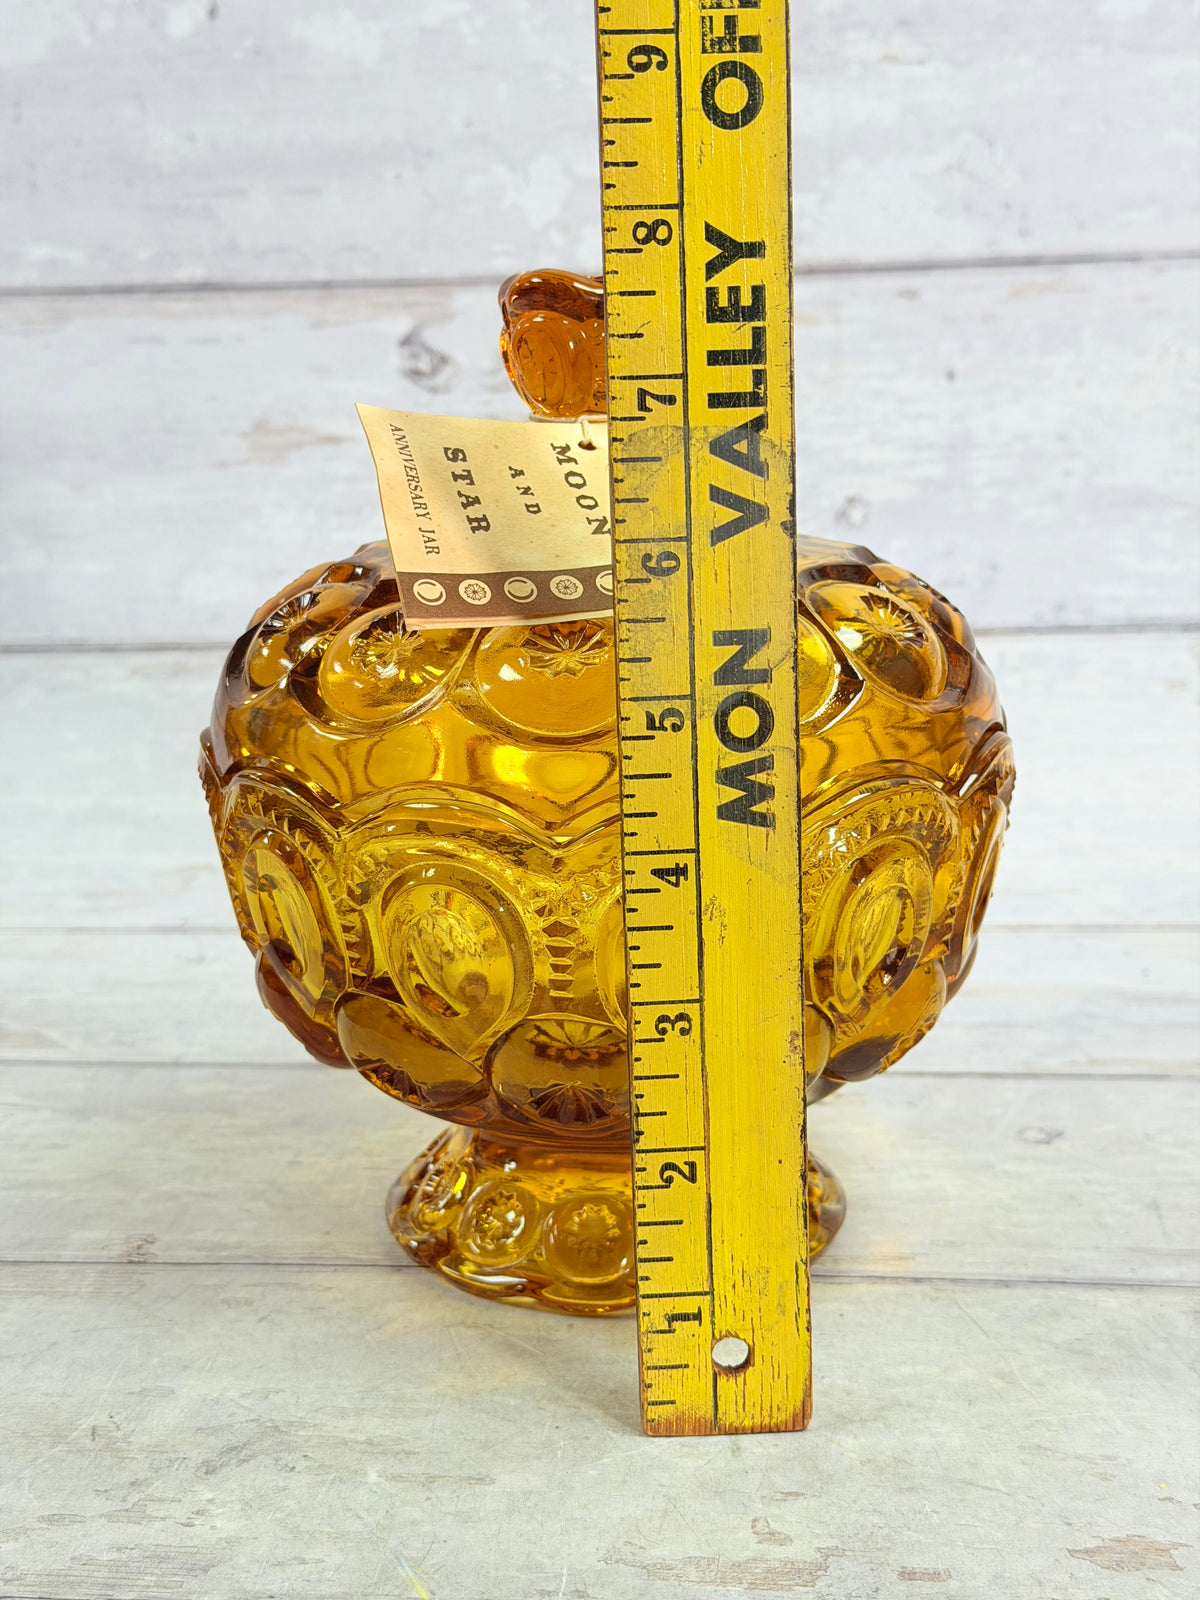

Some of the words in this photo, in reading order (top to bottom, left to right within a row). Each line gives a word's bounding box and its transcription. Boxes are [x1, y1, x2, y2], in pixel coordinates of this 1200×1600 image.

[627, 44, 669, 73] 9
[701, 0, 765, 130] OF
[632, 218, 673, 247] 8
[704, 221, 769, 547] VALLEY
[637, 387, 677, 413] 7
[389, 423, 432, 521] ANNIVERSARY
[418, 527, 441, 556] JAR
[443, 446, 491, 534] STAR
[508, 466, 542, 515] AND
[550, 442, 611, 536] MOON
[641, 550, 681, 578] 6
[645, 707, 685, 733] 5
[712, 628, 775, 830] MON
[650, 862, 689, 888] 4
[654, 1012, 694, 1037] 3
[658, 1160, 698, 1185] 2
[667, 1305, 703, 1328] 1
